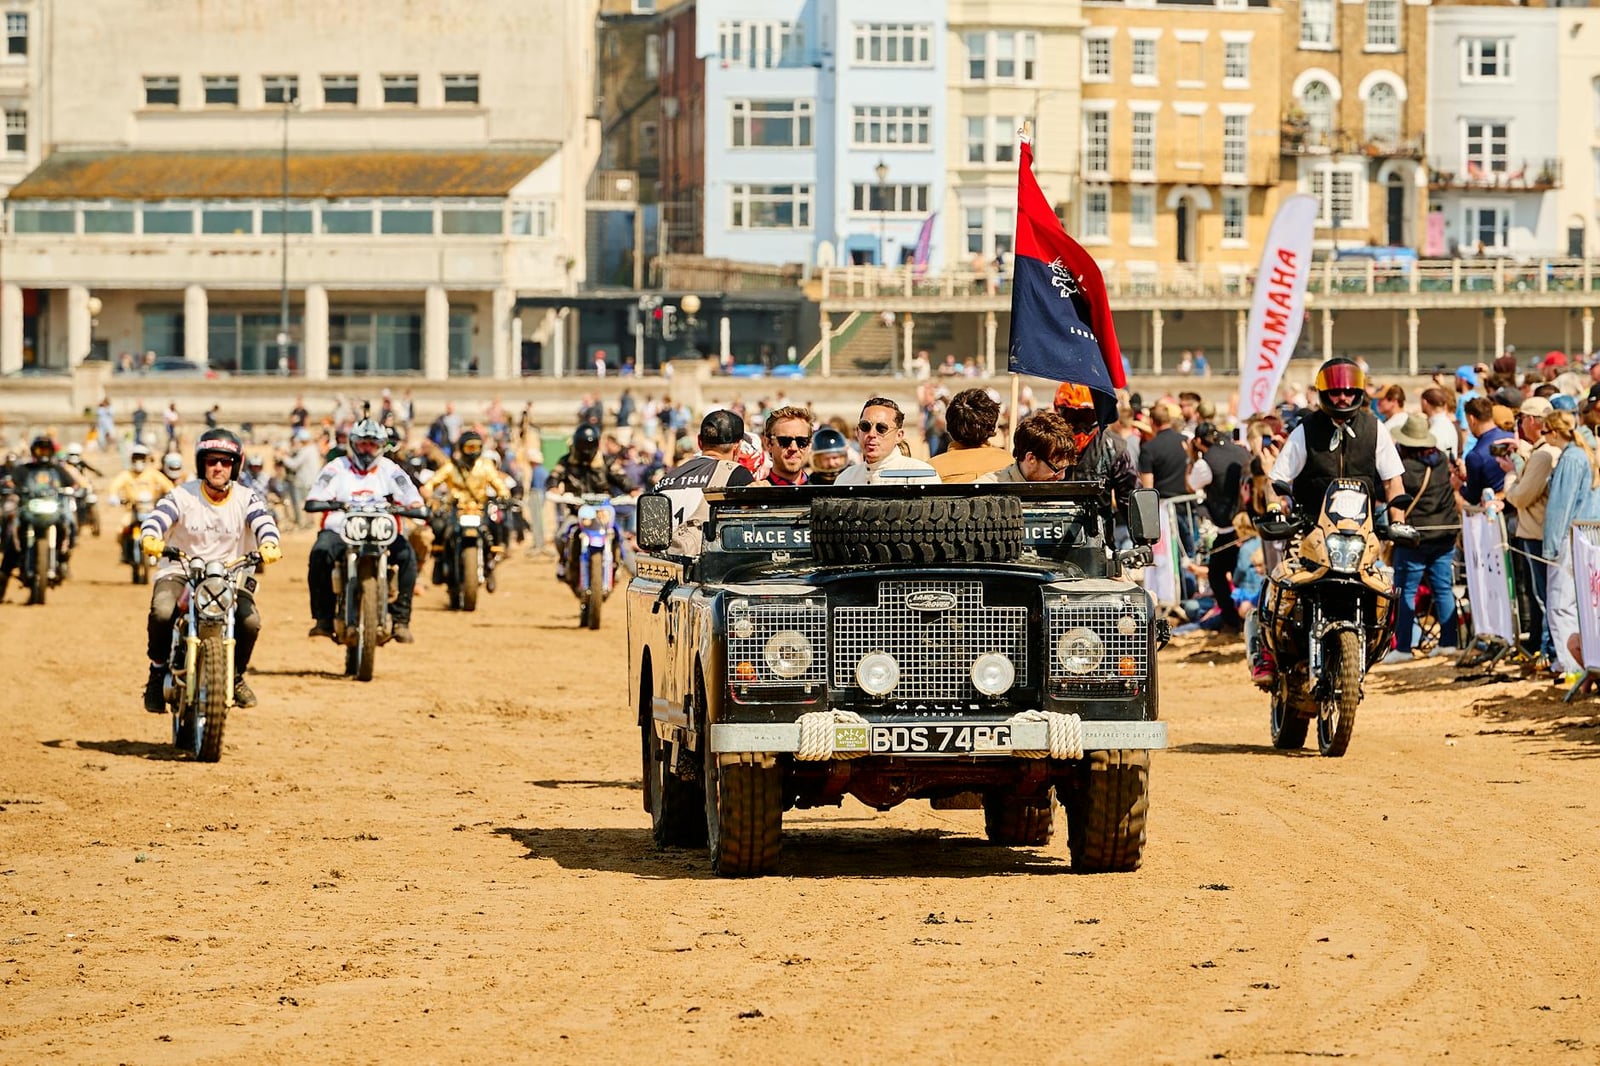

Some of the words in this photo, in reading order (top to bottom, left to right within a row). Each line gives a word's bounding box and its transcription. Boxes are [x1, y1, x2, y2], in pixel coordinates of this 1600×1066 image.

[1257, 248, 1298, 371] YAMAHA
[652, 477, 676, 492] RESS
[743, 531, 786, 543] RACE
[1021, 526, 1063, 539] ICES
[872, 727, 929, 751] BDS
